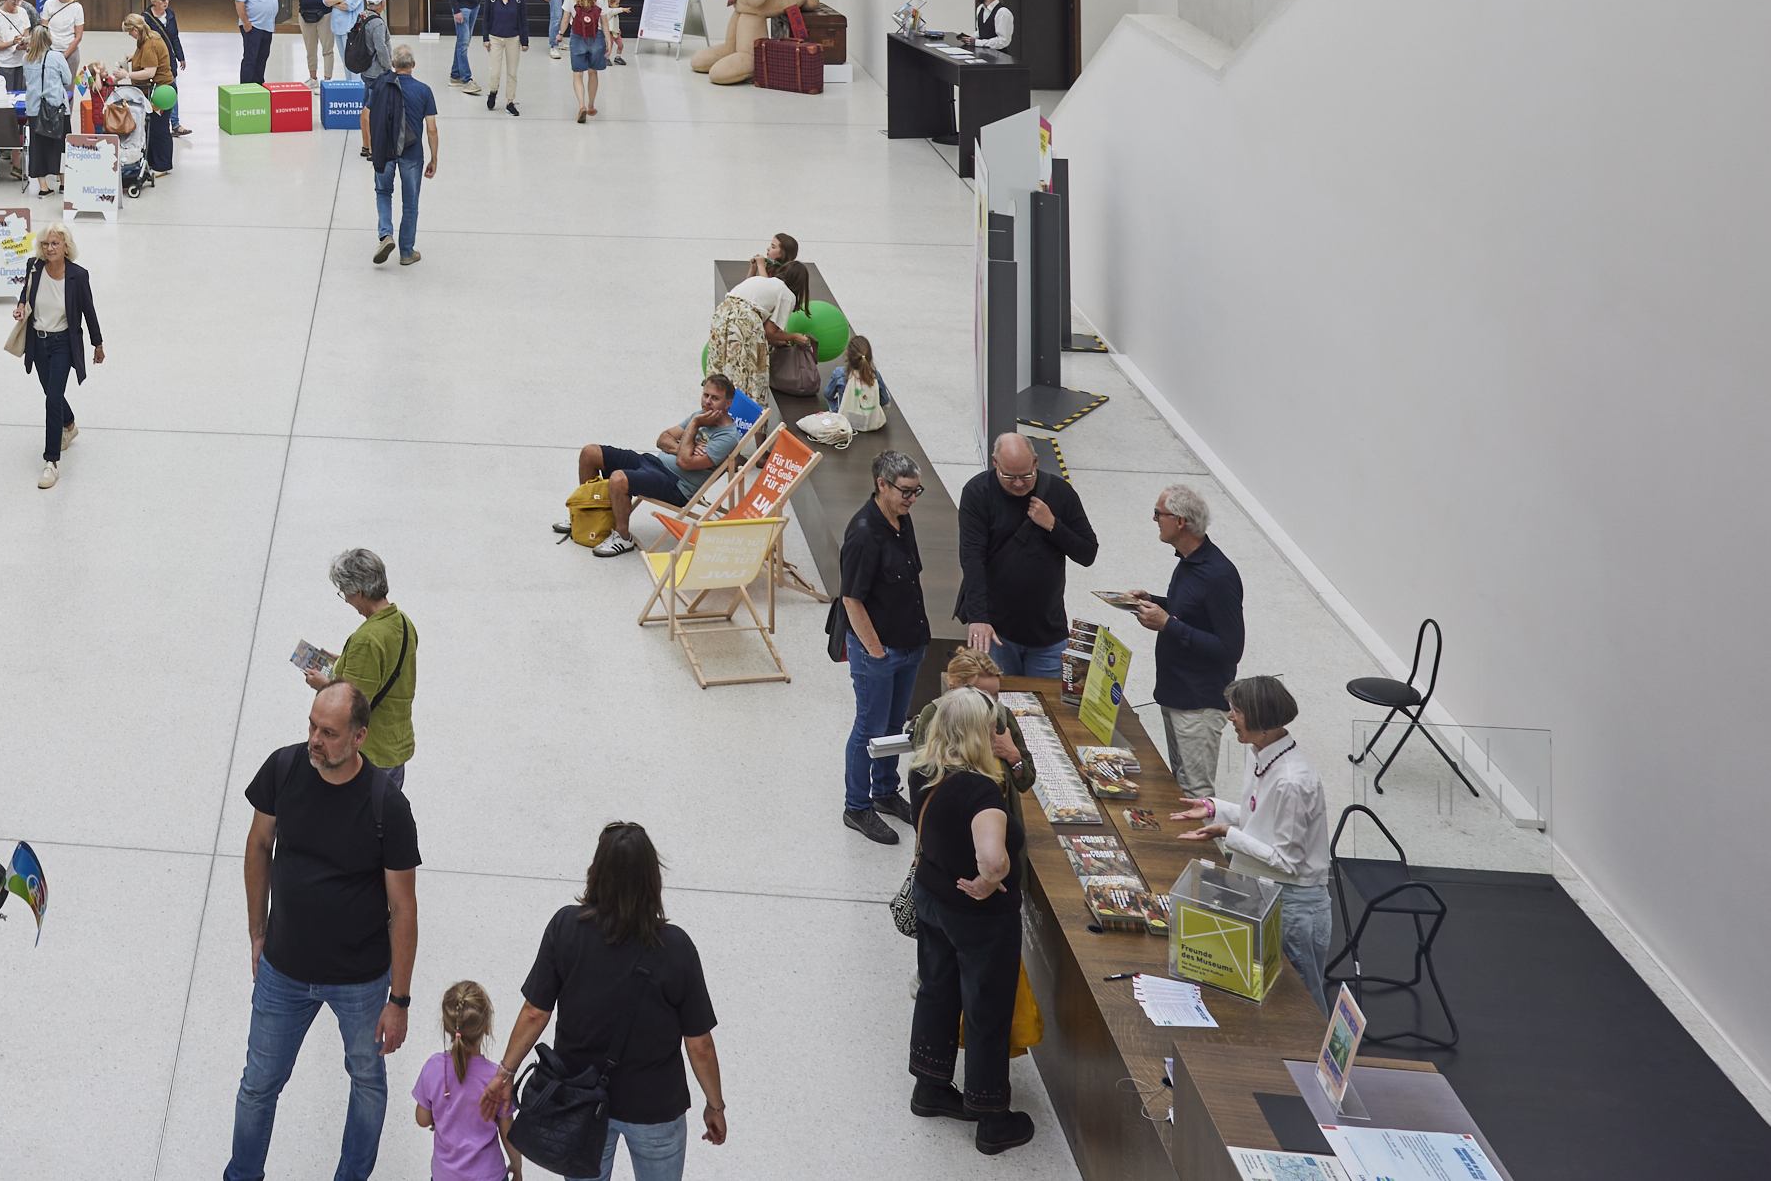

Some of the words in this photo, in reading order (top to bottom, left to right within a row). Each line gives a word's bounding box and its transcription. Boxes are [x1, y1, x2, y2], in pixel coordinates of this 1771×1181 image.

[275, 106, 309, 114] MITEINANDER
[328, 101, 363, 109] TEILHABE
[235, 108, 267, 117] SICHERN
[67, 152, 102, 160] Projekte
[82, 186, 116, 194] Münster
[771, 453, 784, 467] Für
[765, 463, 777, 475] Für
[762, 474, 778, 491] Für
[751, 493, 774, 515] LW
[1181, 943, 1213, 959] Freunde
[1181, 952, 1195, 961] des
[1196, 956, 1233, 973] Museums
